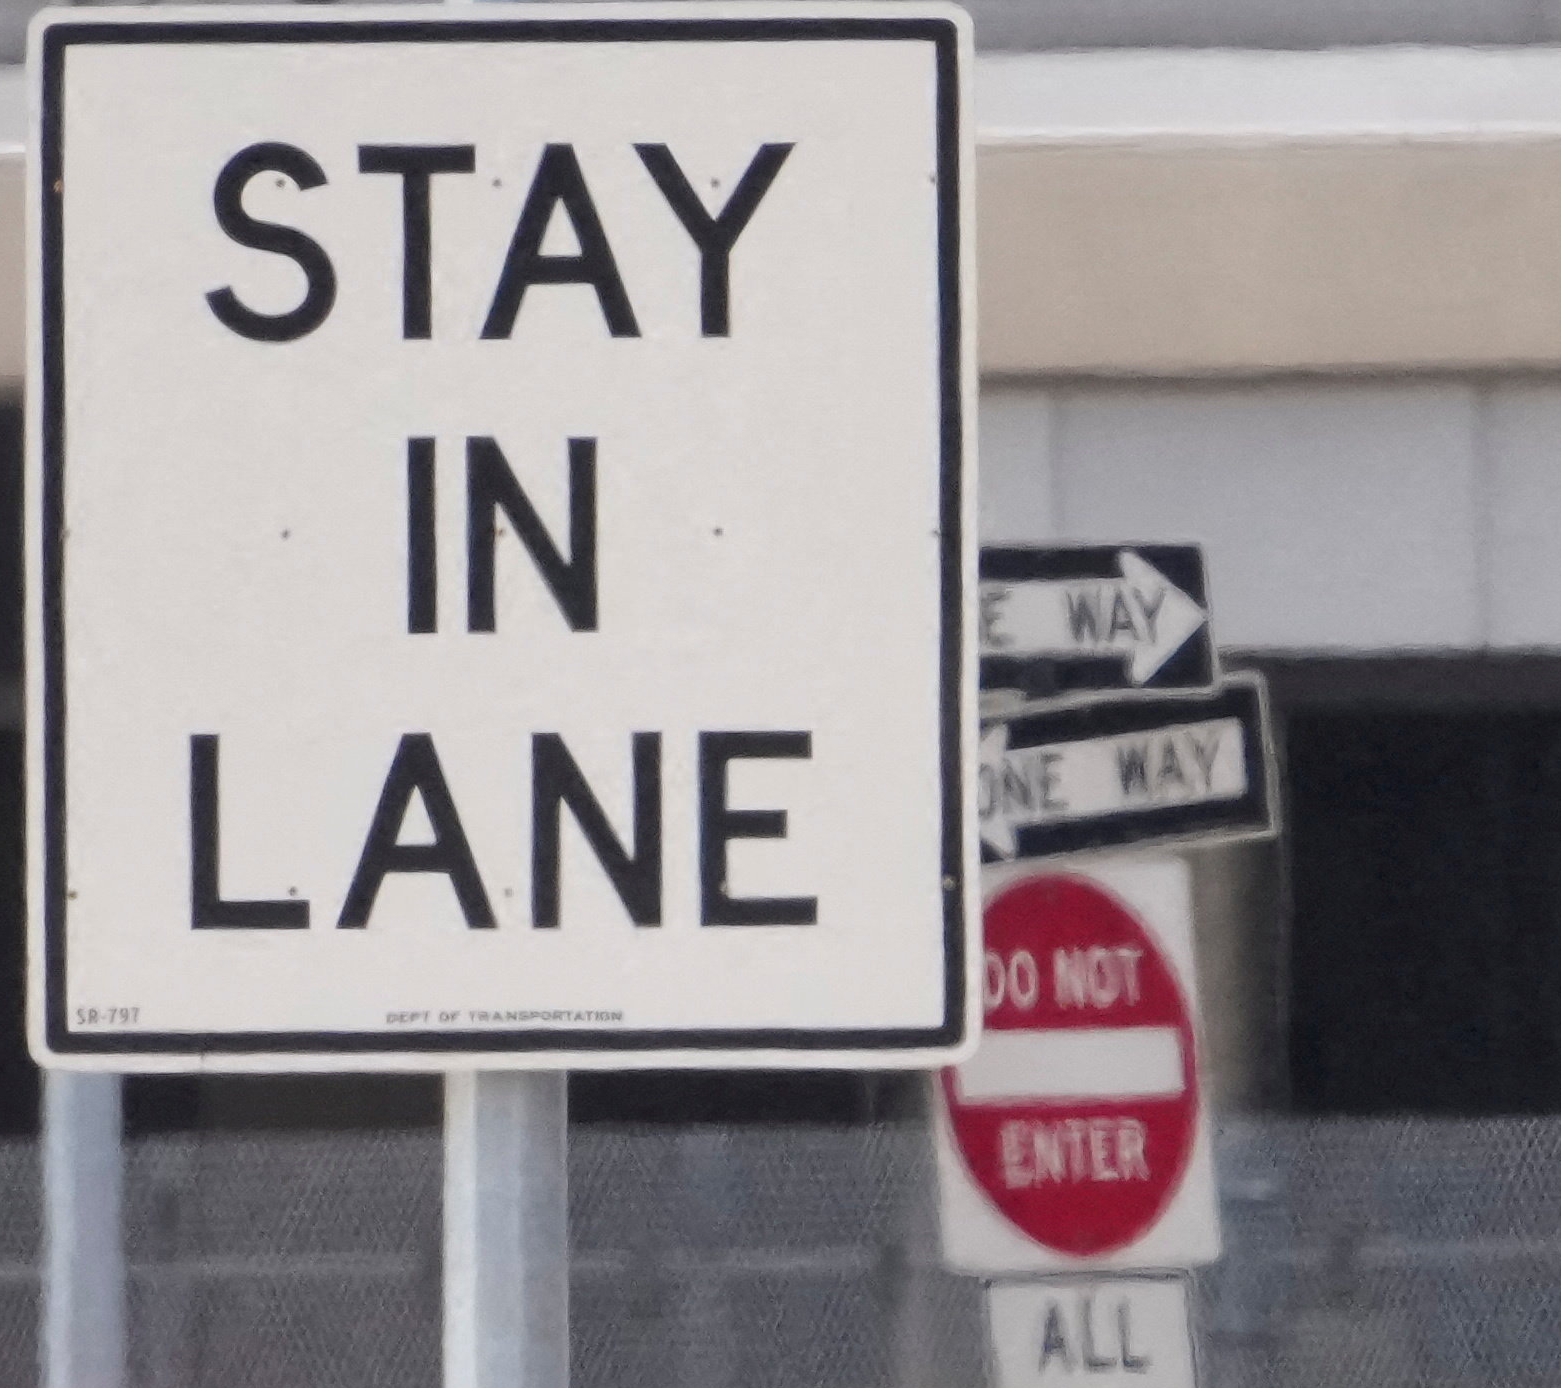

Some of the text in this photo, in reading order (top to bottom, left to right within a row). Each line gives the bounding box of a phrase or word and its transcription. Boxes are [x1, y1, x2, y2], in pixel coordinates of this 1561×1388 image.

[206, 140, 795, 342] STAY
[406, 437, 597, 635] IN
[1064, 588, 1166, 643] WAY
[1116, 733, 1222, 797] WAY
[190, 732, 820, 930] LANE
[983, 948, 1143, 1008] DO NOT
[386, 1010, 623, 1024] DEPT OF TRANSPORTATION
[998, 1118, 1150, 1188] ENTER
[1040, 1300, 1148, 1374] ALL
